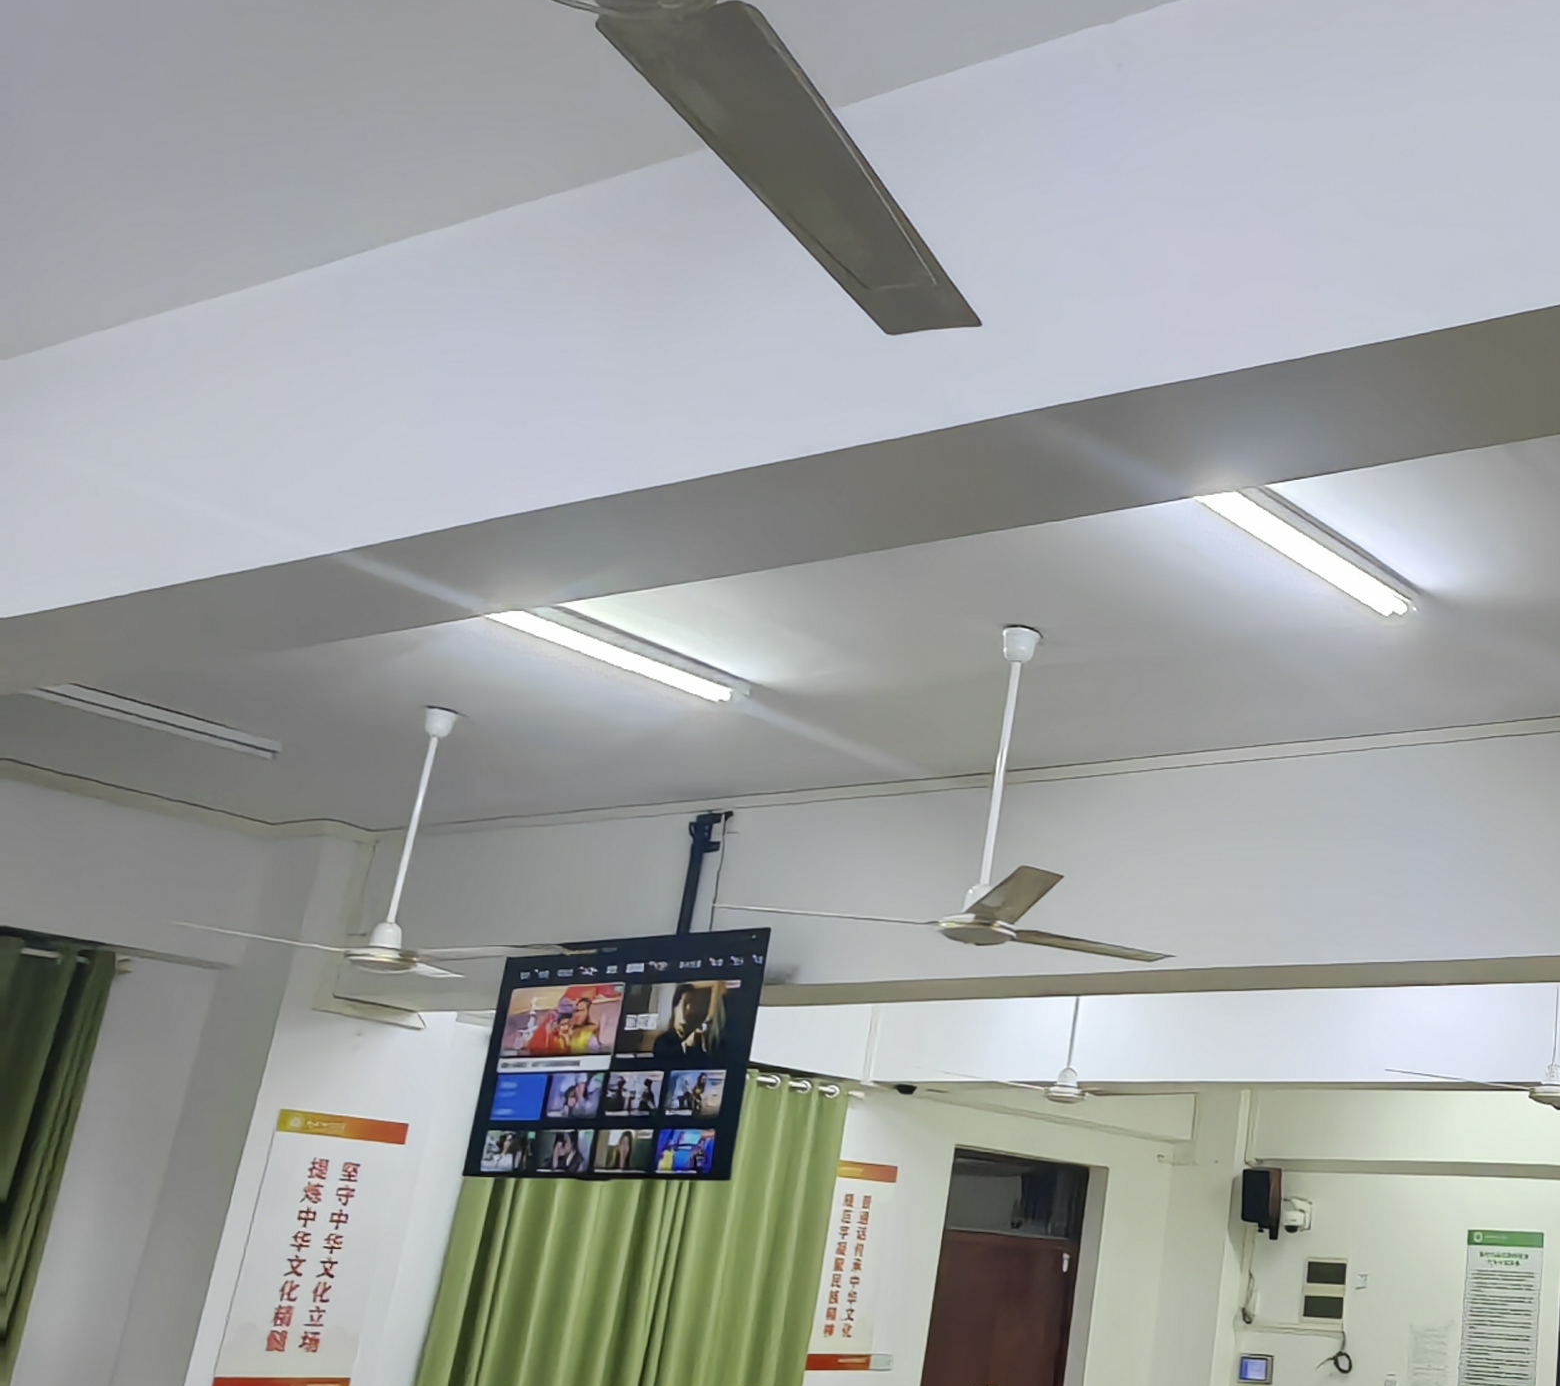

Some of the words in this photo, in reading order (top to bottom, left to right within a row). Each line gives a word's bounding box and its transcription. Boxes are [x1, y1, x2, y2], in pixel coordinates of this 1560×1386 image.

[298, 1161, 361, 1353] 坚守中华文化立场
